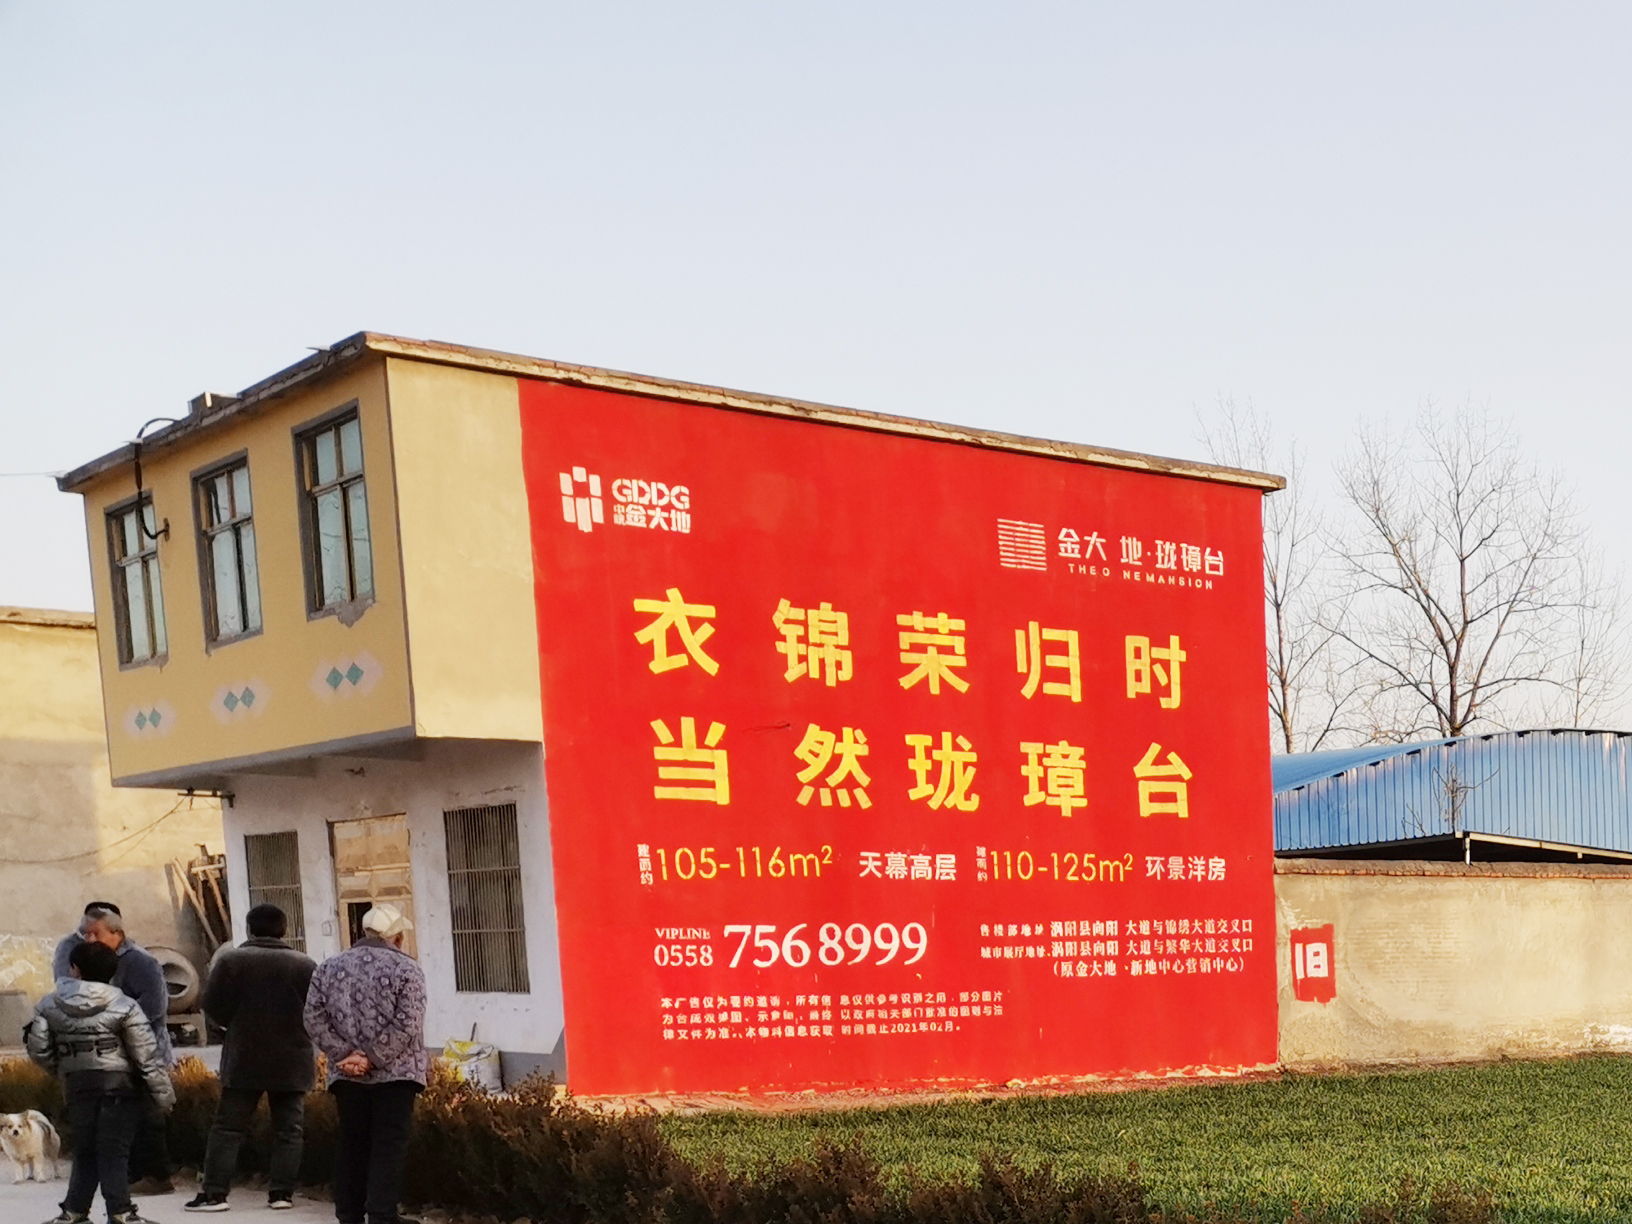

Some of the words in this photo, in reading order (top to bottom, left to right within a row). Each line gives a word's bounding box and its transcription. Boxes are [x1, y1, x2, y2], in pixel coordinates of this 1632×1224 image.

[612, 478, 690, 510] GDDG
[633, 588, 1187, 709] 衣锦荣归时
[650, 716, 1192, 818] 当然珑璋台
[859, 852, 957, 881] 天幕高层
[1146, 856, 1227, 882] 环景洋房
[654, 944, 714, 967] 0558
